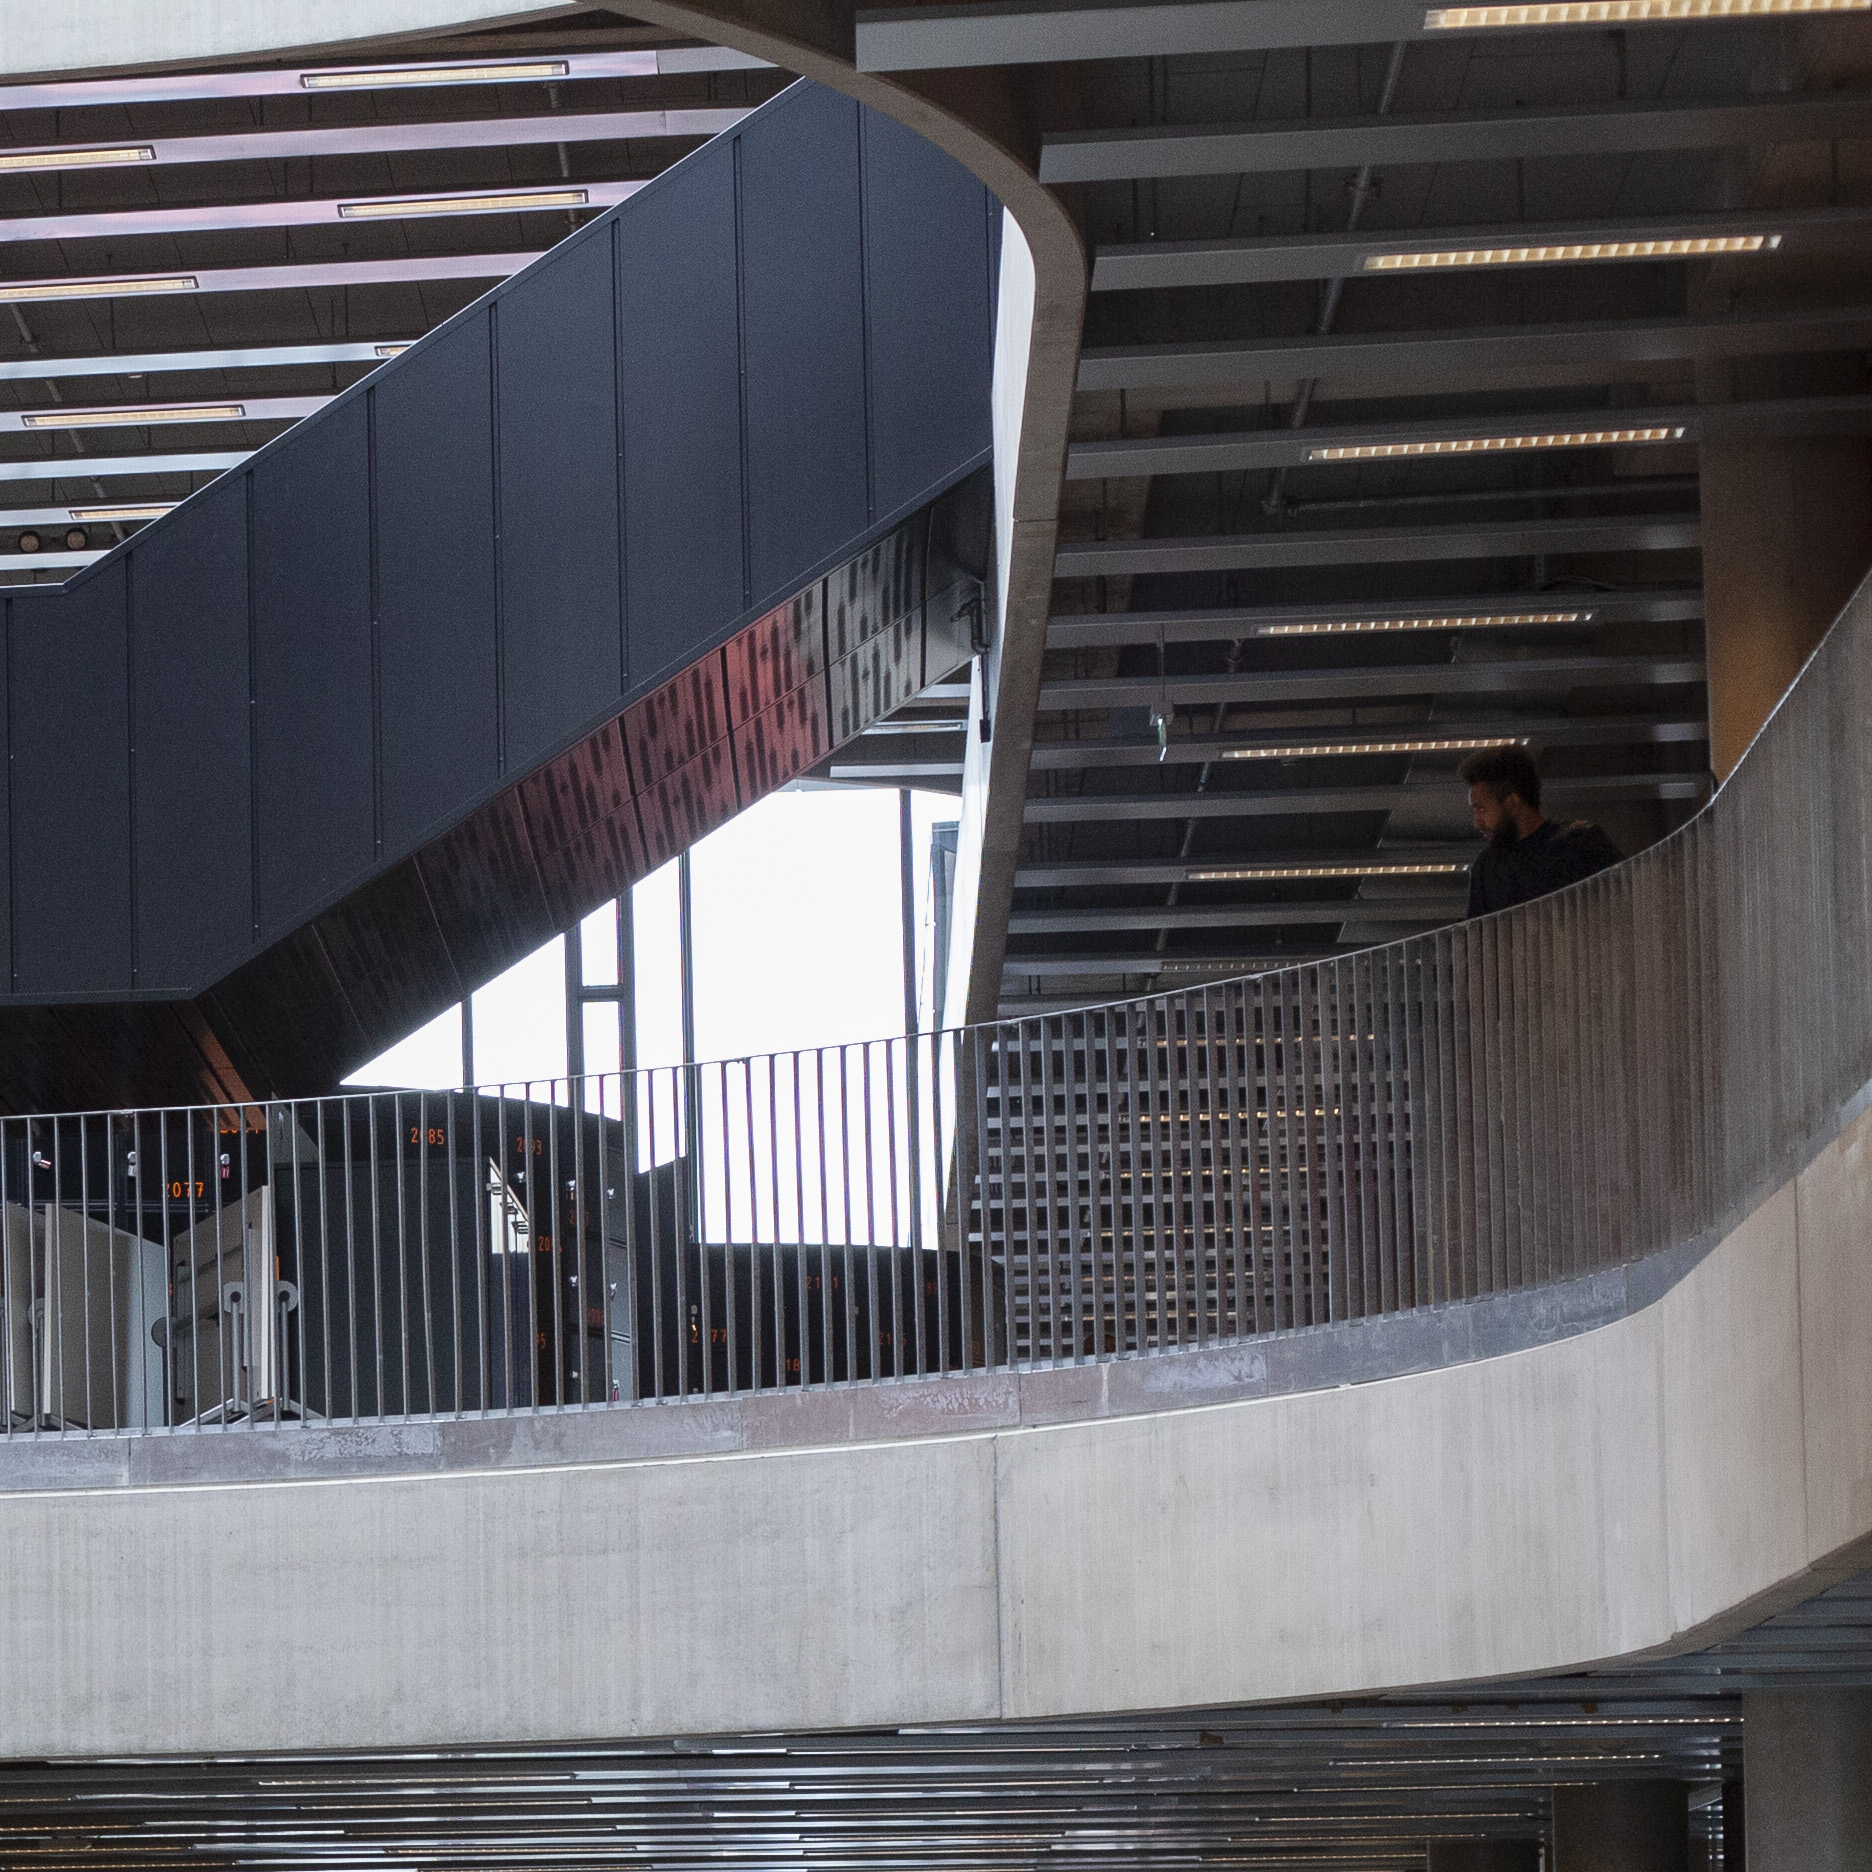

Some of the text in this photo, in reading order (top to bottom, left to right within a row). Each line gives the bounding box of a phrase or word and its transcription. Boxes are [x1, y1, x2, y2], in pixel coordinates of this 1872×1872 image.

[410, 1127, 445, 1145] 285
[161, 1180, 205, 1198] 077
[806, 1276, 839, 1290] 211
[690, 1328, 728, 1344] 277
